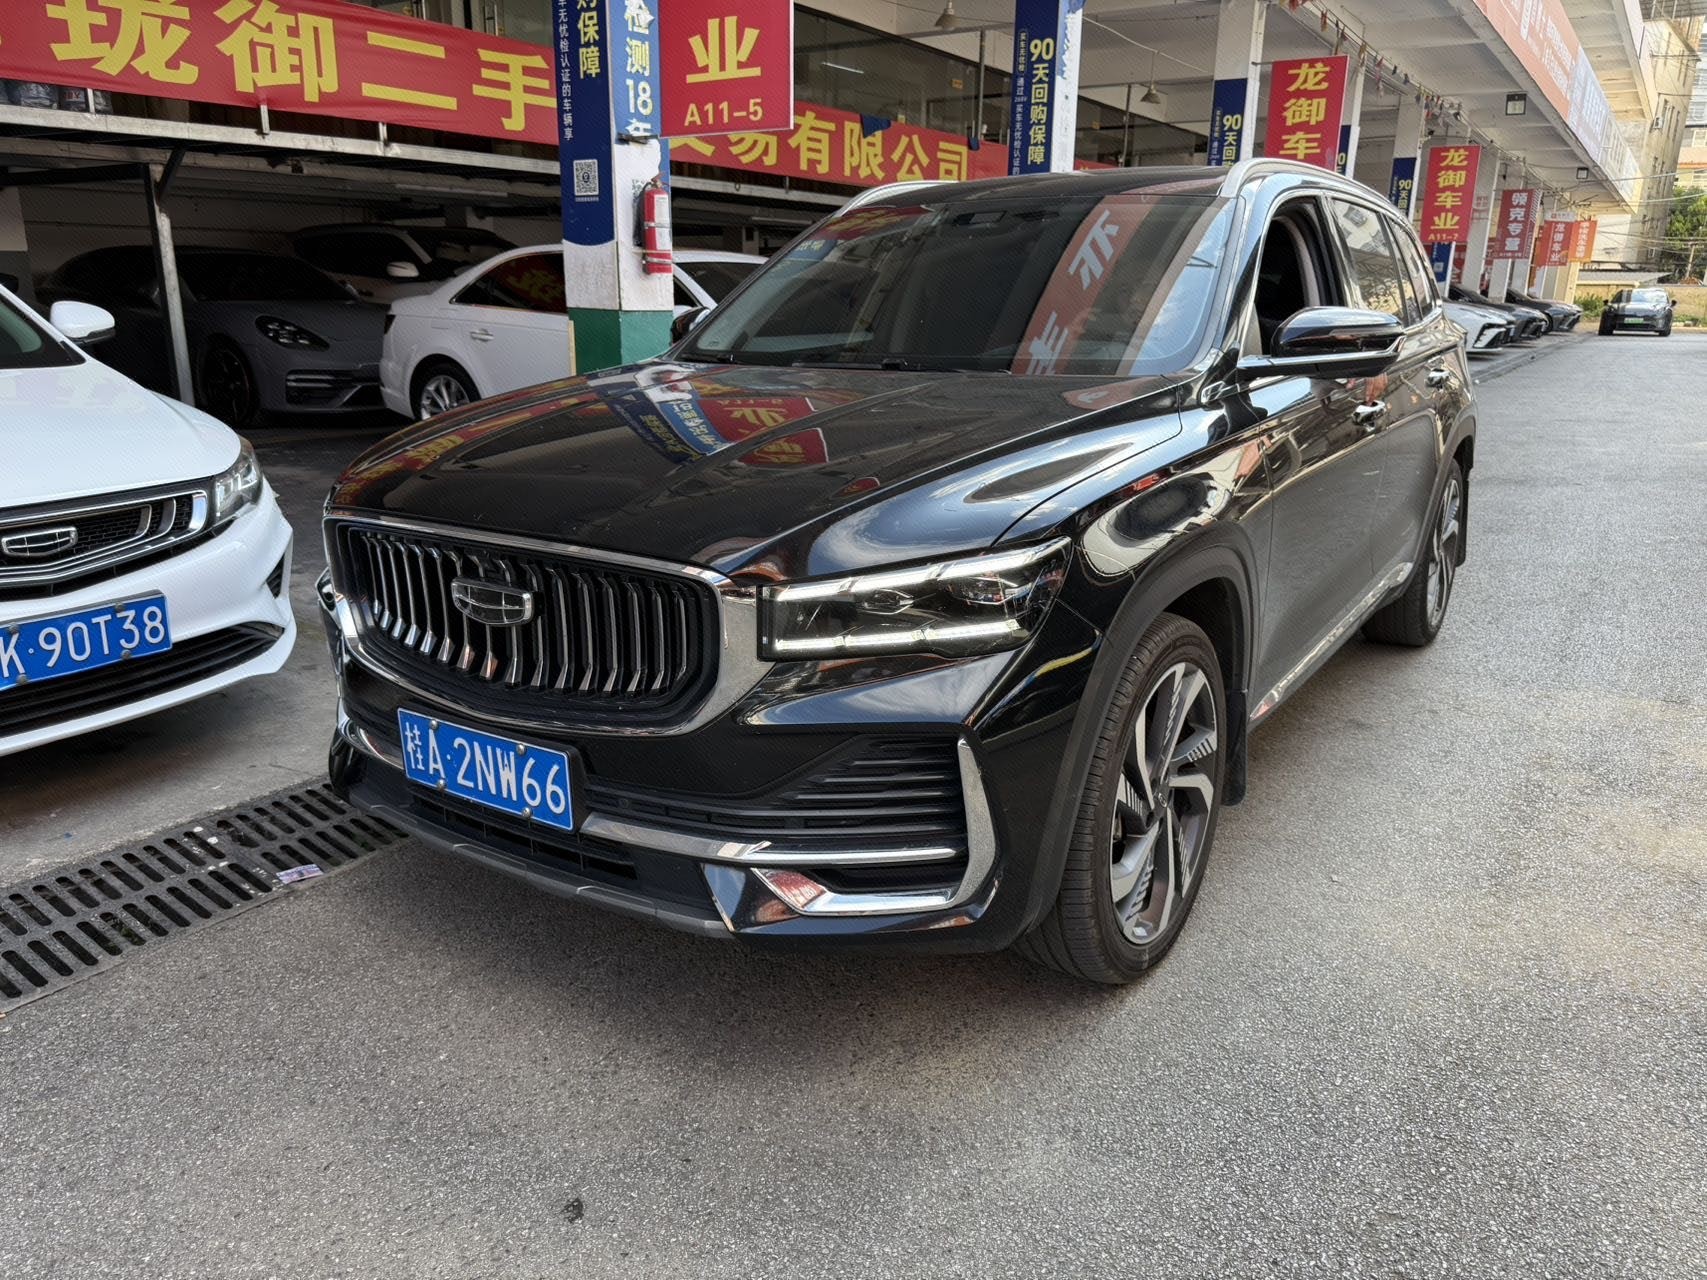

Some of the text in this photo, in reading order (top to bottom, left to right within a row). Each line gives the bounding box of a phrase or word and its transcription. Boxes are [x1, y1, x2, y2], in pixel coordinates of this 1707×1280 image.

[576, 0, 600, 79] 保障
[686, 16, 761, 84] 业
[684, 98, 763, 127] A11-5
[1027, 37, 1055, 166] 90天回购保障
[1280, 62, 1331, 160] 龙御车
[1430, 148, 1469, 229] 龙御车业
[1504, 192, 1529, 251] 领克专营
